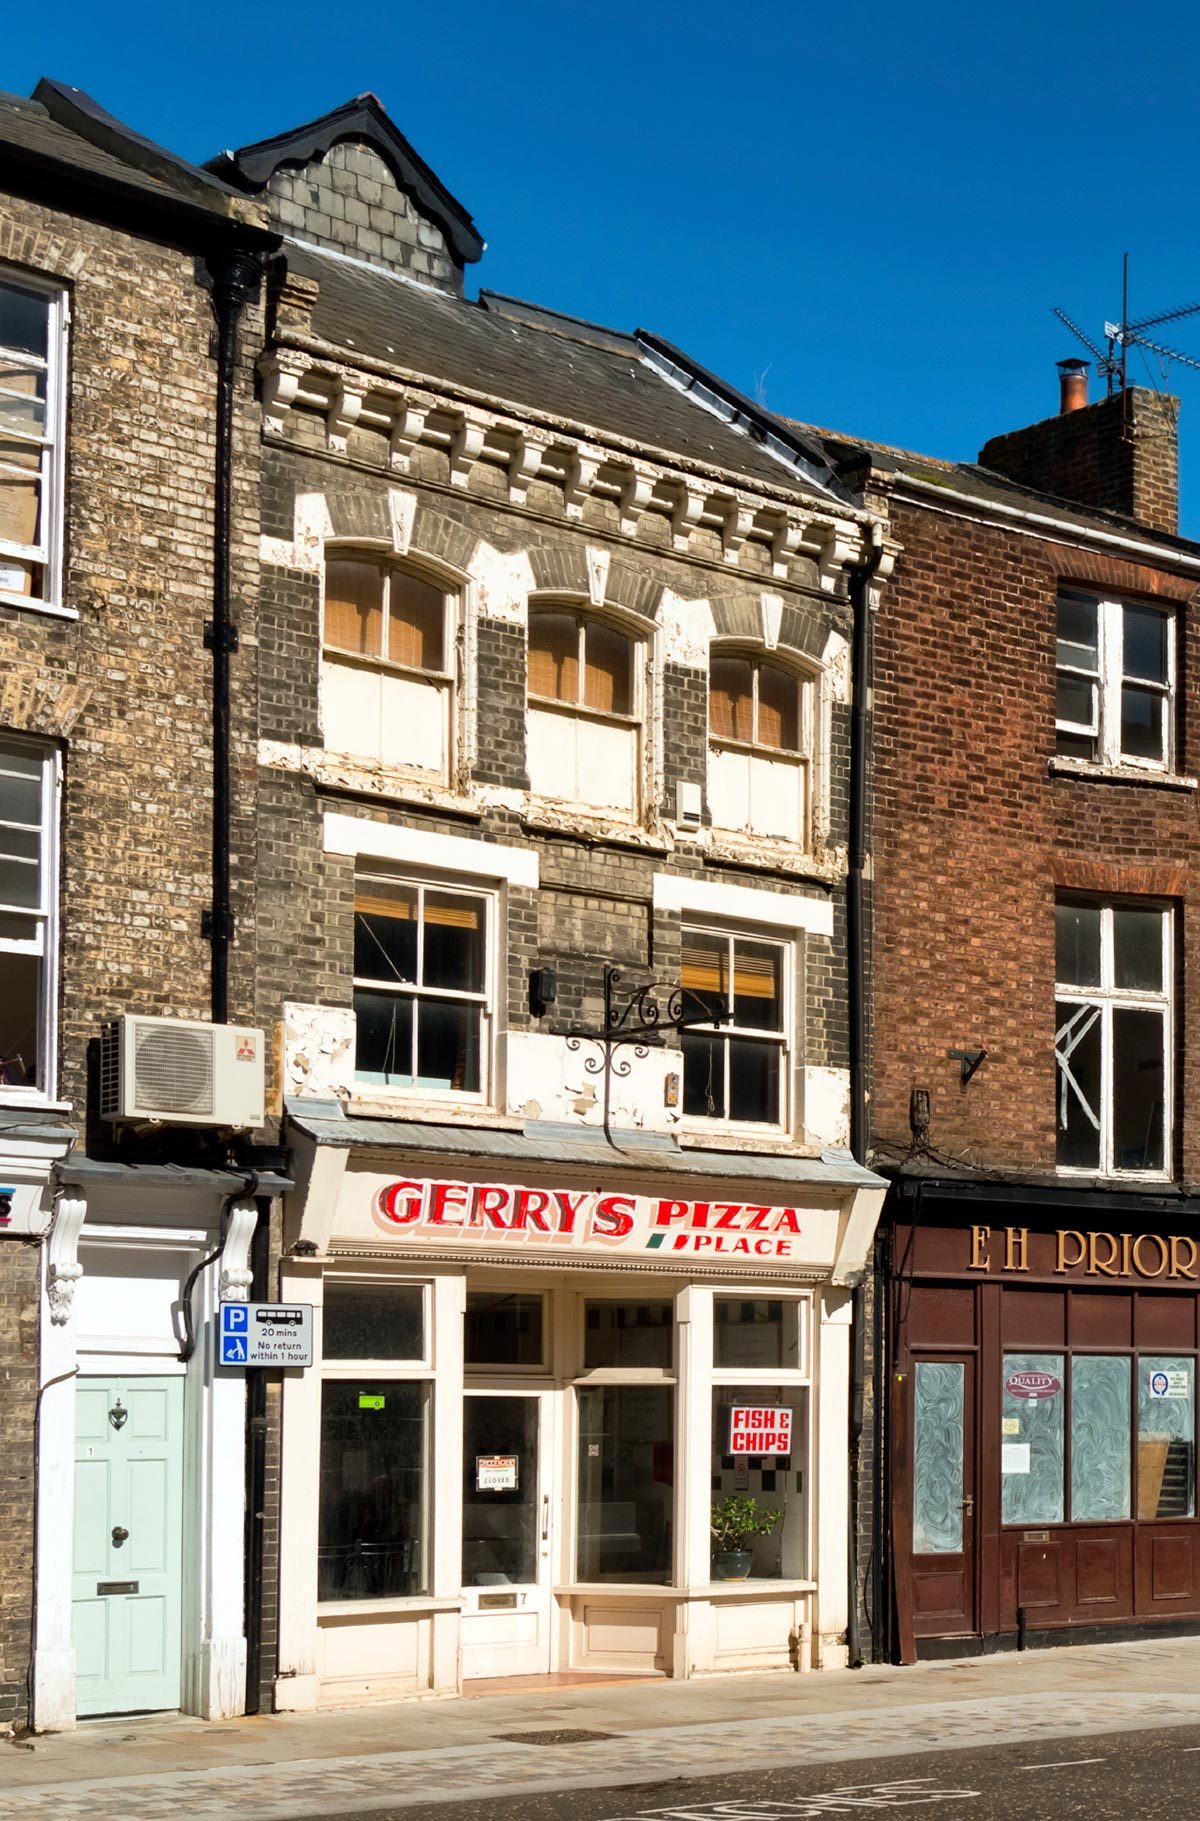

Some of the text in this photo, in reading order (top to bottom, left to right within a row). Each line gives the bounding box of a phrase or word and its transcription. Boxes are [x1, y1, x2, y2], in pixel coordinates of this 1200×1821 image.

[378, 1180, 802, 1238] GERRY'S PIZZA
[693, 1234, 793, 1256] PLACE
[969, 1225, 991, 1271] E
[1004, 1226, 1030, 1271] H
[1054, 1229, 1199, 1280] PRIOR
[229, 1308, 245, 1330] P
[261, 1328, 298, 1337] 20 mins
[257, 1341, 302, 1350] No return
[250, 1351, 309, 1361] within 1 hour
[1009, 1376, 1056, 1387] QUALITY
[733, 1410, 775, 1429] FISH
[732, 1432, 788, 1452] CHIPS
[520, 1592, 528, 1605] 7
